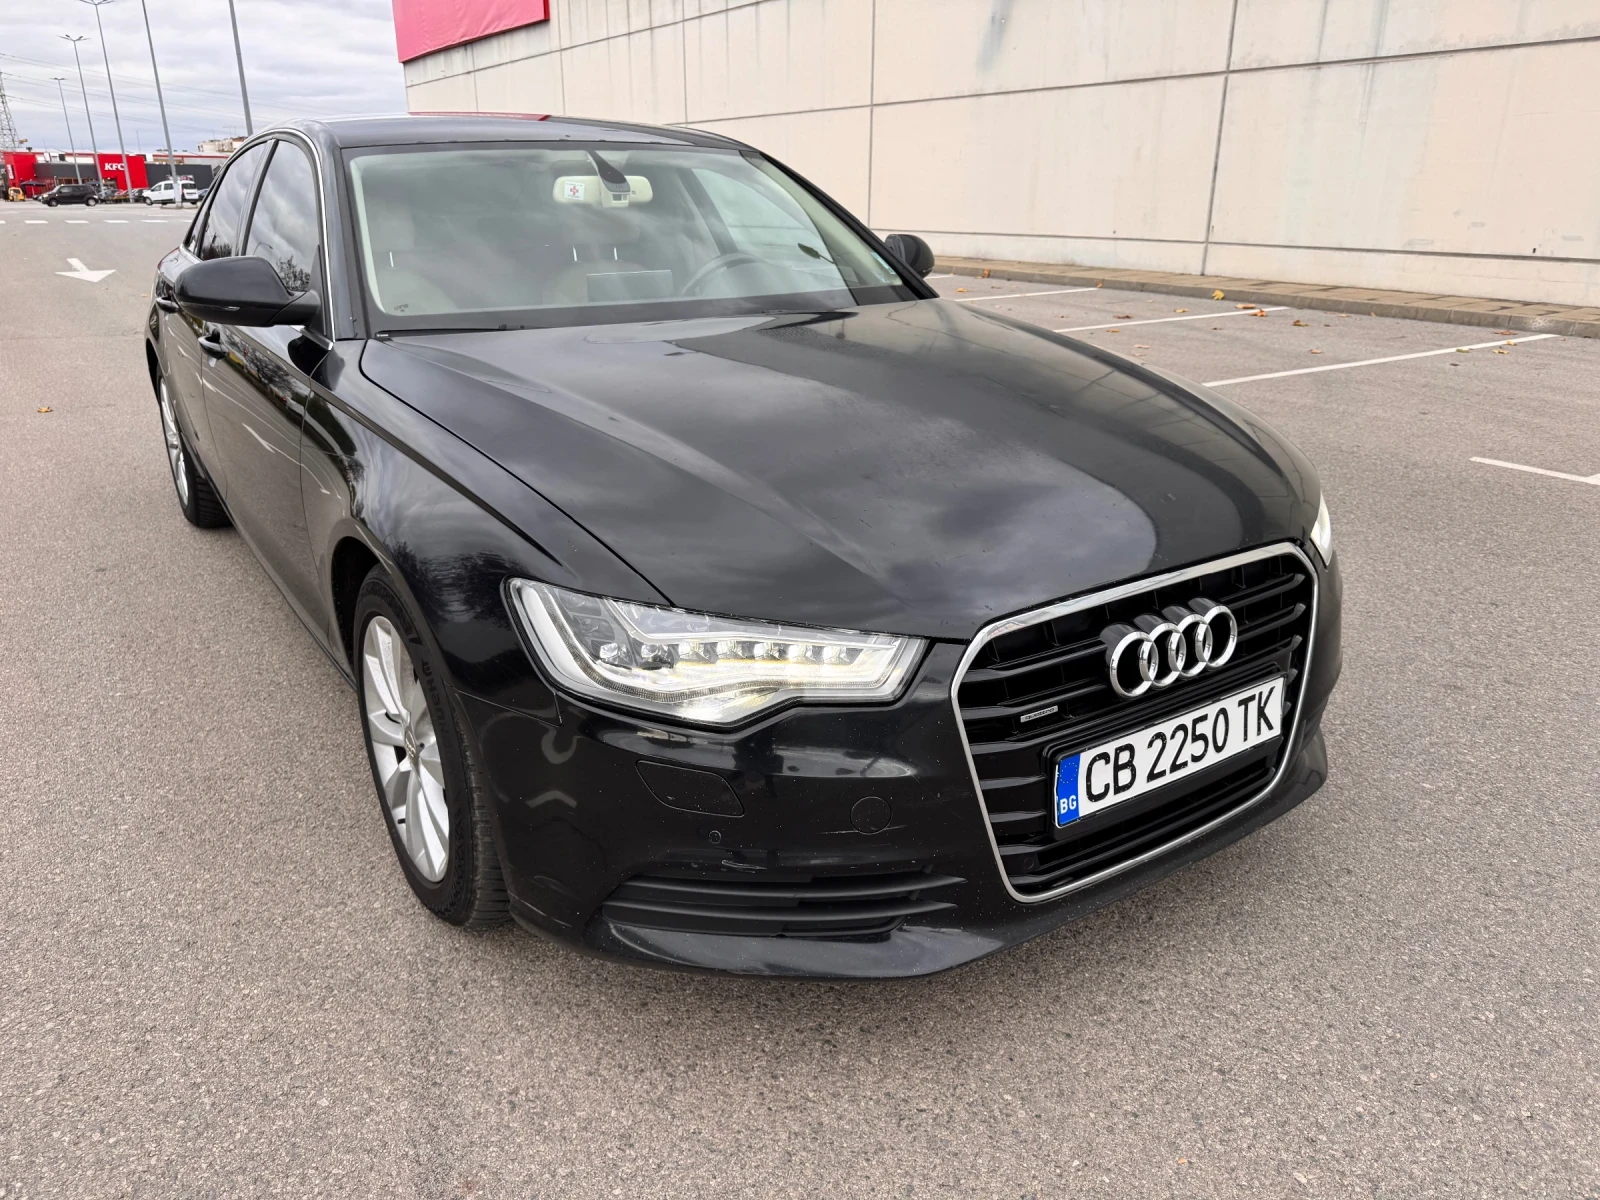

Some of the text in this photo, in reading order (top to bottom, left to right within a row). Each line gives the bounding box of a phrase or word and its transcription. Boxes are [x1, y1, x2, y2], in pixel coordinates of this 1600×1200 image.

[104, 163, 125, 171] KFC
[1086, 685, 1276, 803] CB 2250 TK
[1060, 795, 1077, 814] BG
